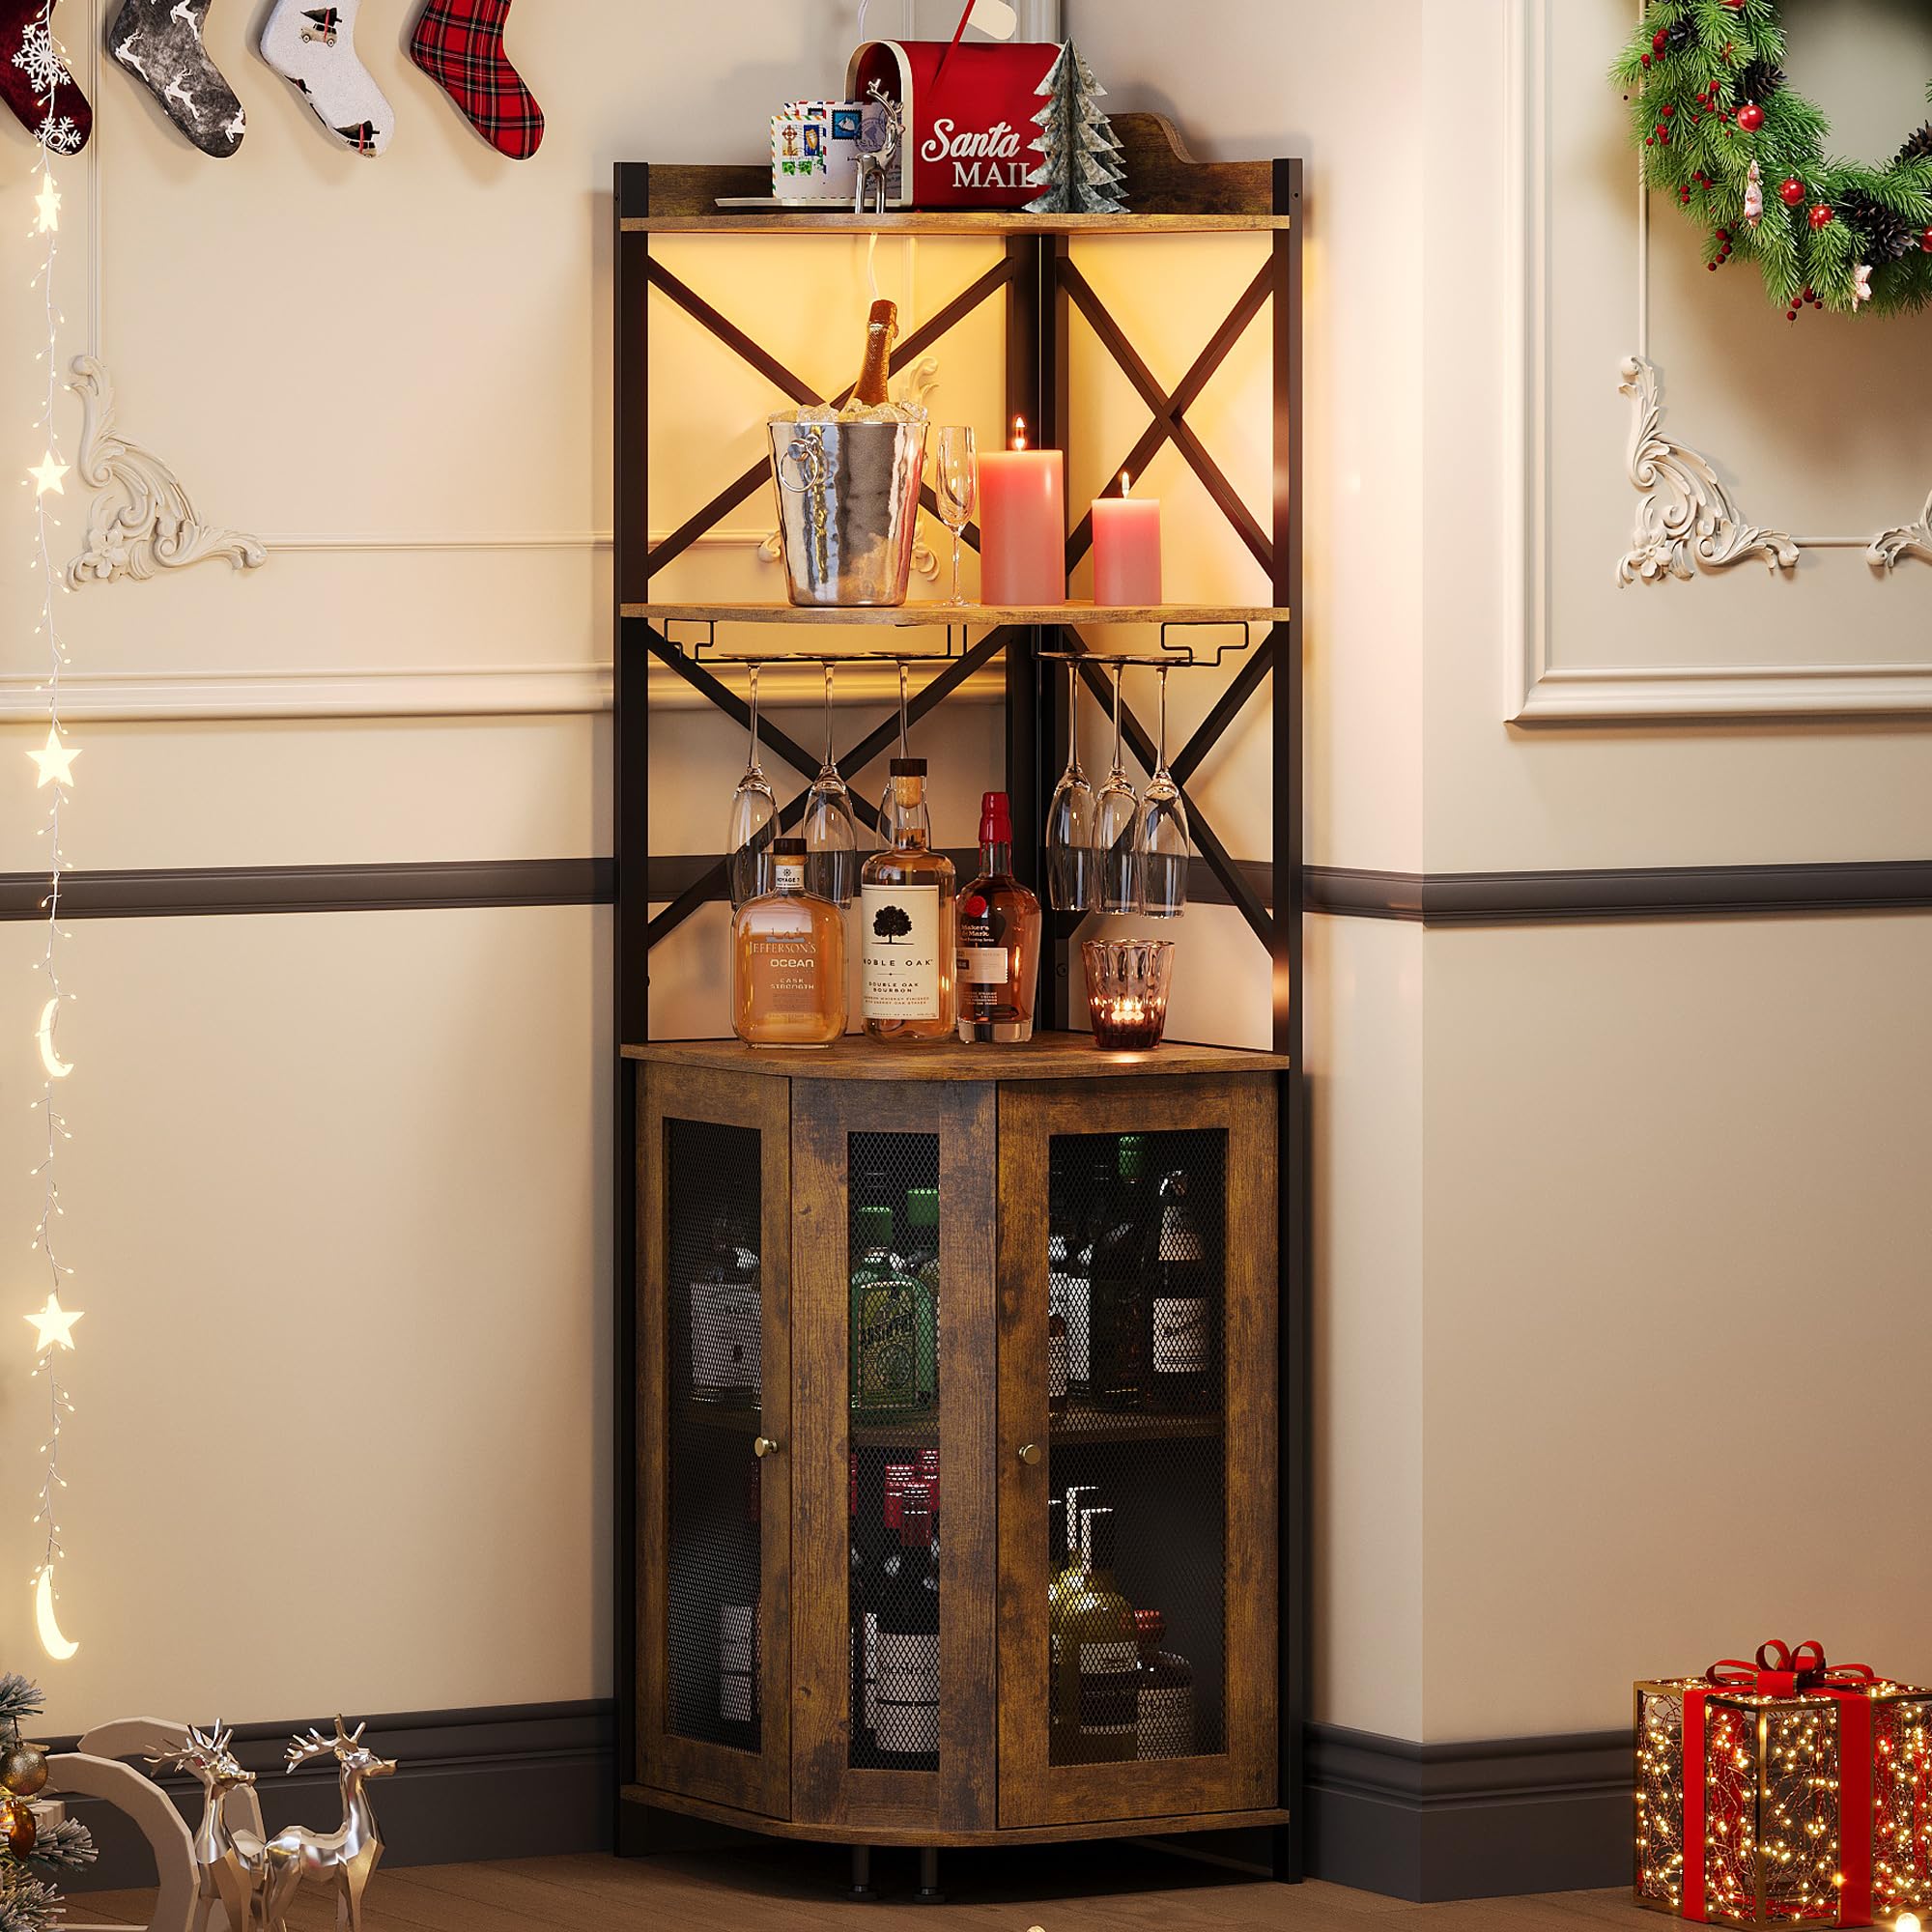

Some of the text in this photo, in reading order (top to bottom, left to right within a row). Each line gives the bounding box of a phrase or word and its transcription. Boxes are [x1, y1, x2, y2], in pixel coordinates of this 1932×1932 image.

[922, 118, 1020, 162] Santa
[952, 161, 1037, 188] MAIL
[750, 941, 816, 955] JEFFERSON'S
